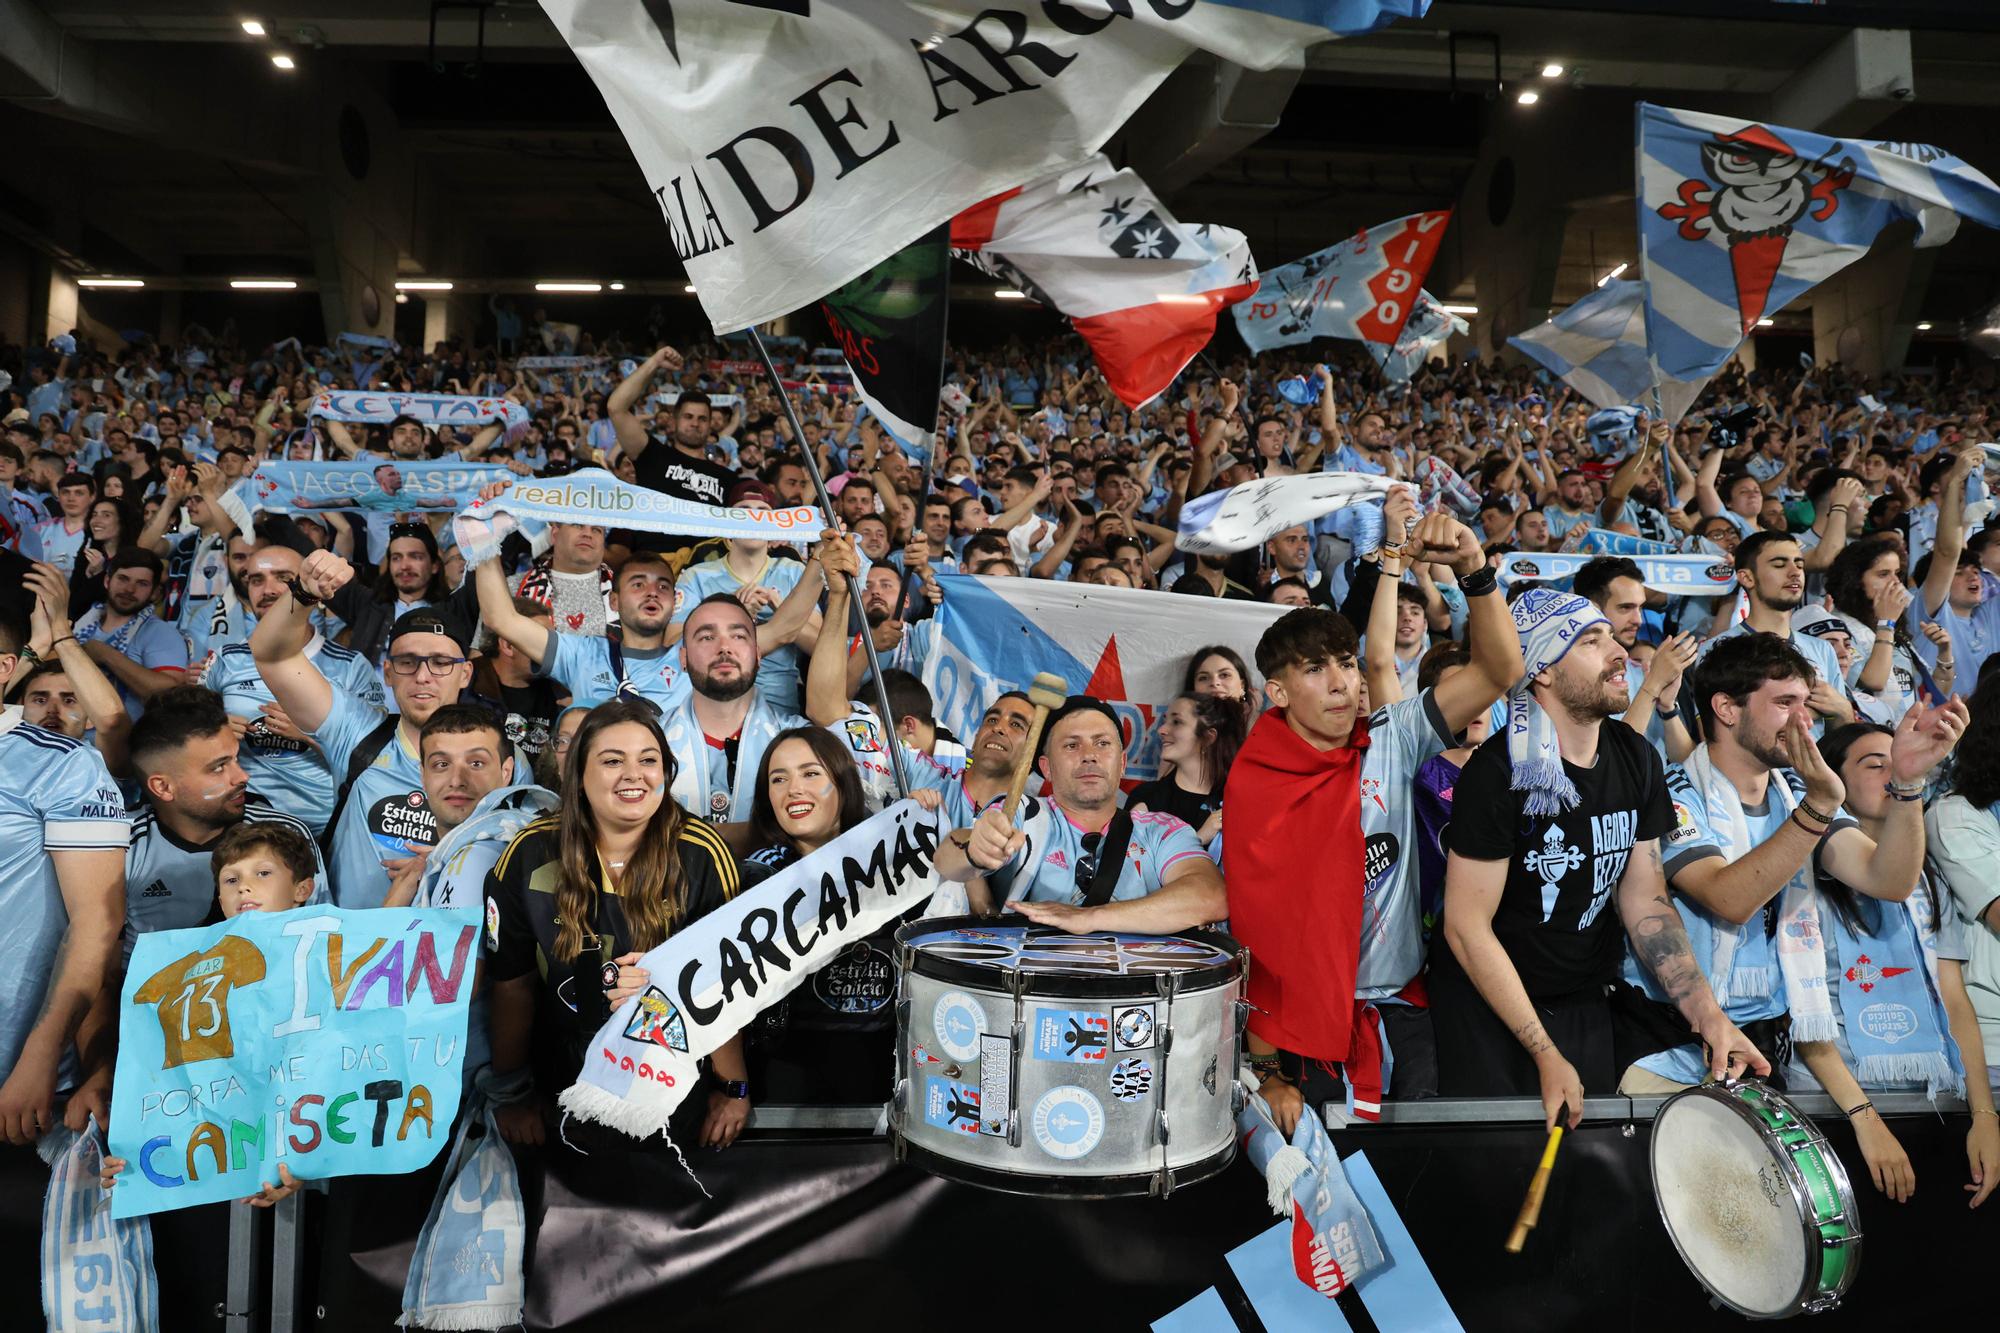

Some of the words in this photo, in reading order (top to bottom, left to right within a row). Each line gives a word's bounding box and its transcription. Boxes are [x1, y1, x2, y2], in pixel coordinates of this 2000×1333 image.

[706, 68, 900, 233] DE
[330, 396, 479, 419] CELTA
[289, 470, 376, 497] IAGO
[1648, 563, 1693, 583] lta
[252, 734, 301, 750] Galicia
[96, 788, 119, 803] VISIT
[381, 802, 438, 828] Estrella
[381, 818, 433, 843] Galicia
[1669, 826, 1697, 843] LaLiga
[1364, 856, 1391, 882] icia
[272, 914, 478, 1039] IVÁN
[169, 973, 225, 1042] 13
[141, 1075, 246, 1122] PORFA
[269, 1056, 308, 1089] ME
[342, 1043, 390, 1072] DAS
[408, 1034, 458, 1068] TU
[602, 1047, 676, 1088] 1998
